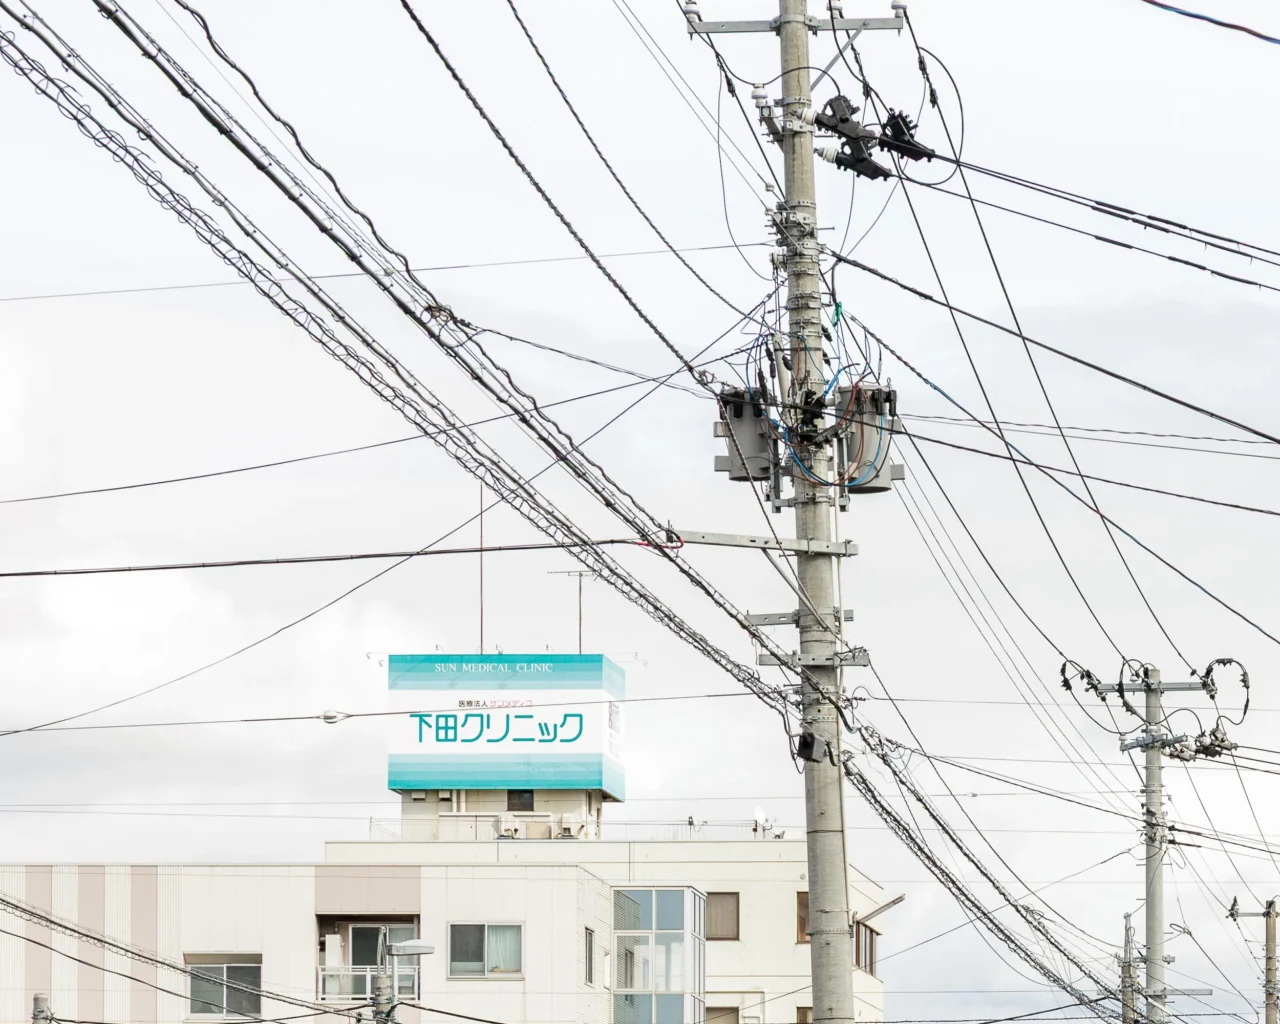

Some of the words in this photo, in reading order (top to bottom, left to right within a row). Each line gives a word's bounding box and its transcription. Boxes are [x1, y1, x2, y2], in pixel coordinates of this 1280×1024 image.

[435, 663, 457, 673] SUN
[462, 663, 512, 673] MEDICAL
[516, 663, 553, 673] CLINIC
[409, 713, 584, 743] 下田クリニック
